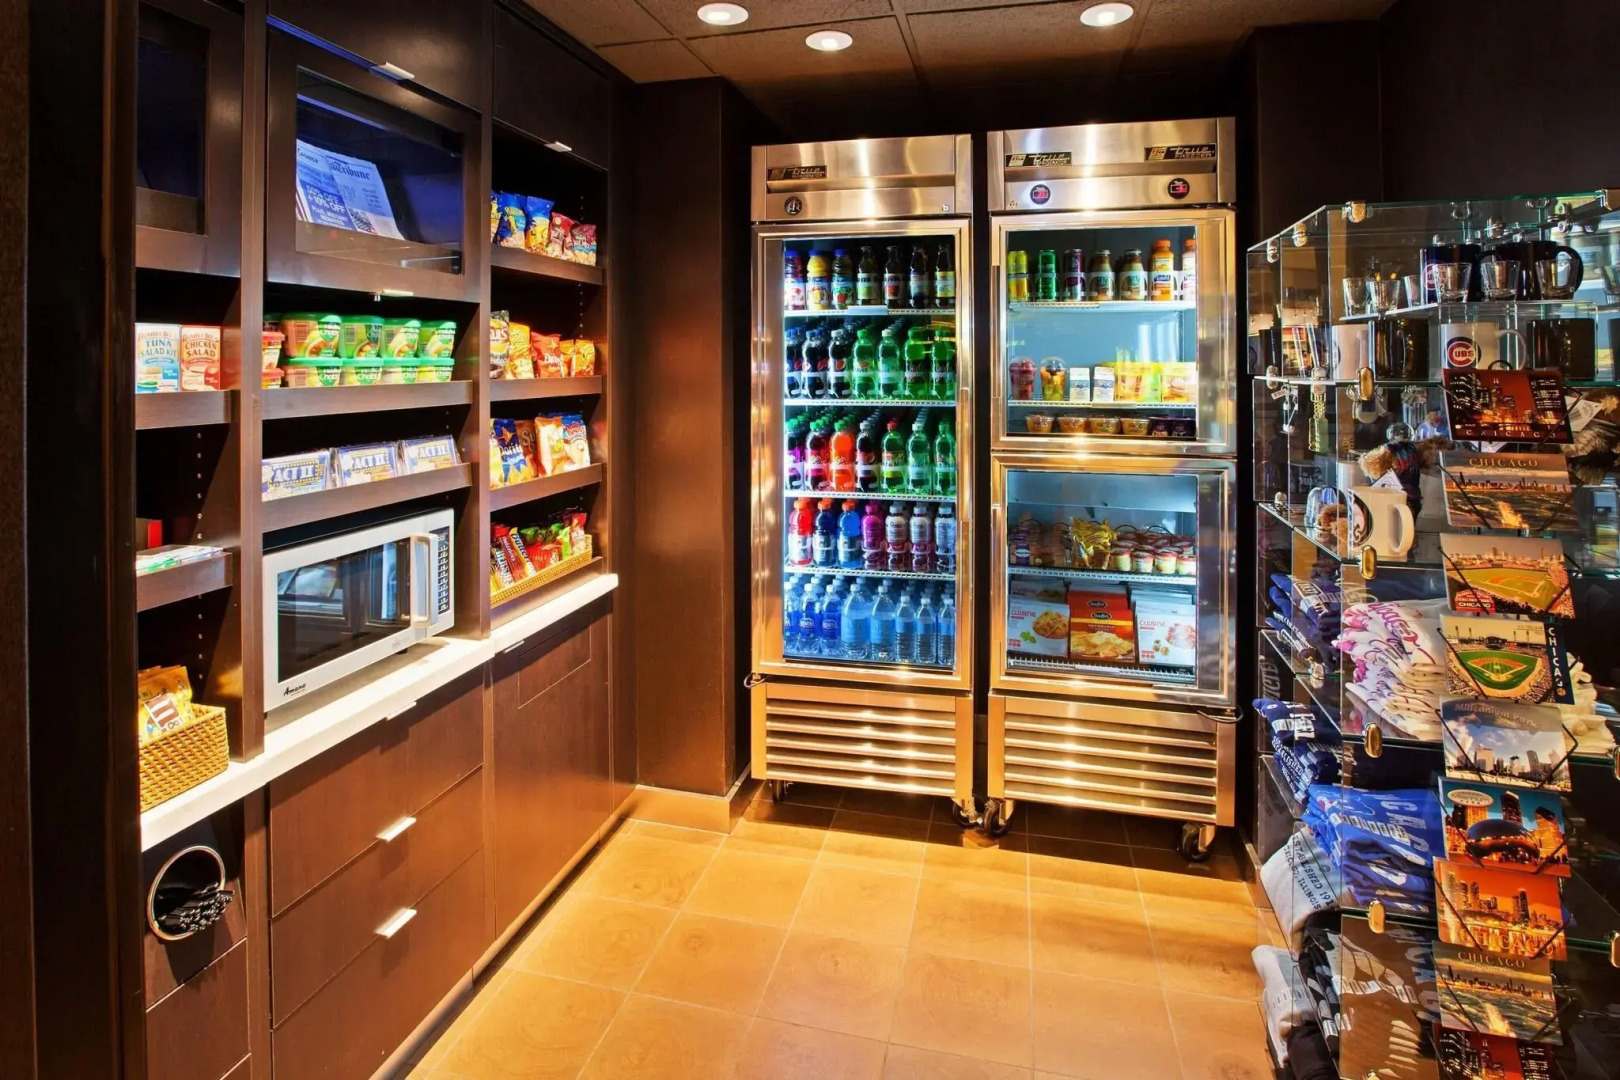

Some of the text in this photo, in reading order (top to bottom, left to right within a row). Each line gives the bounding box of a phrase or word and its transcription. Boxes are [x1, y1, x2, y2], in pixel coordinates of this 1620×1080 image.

[331, 201, 346, 213] OFF
[145, 339, 172, 348] TUNA
[185, 341, 217, 350] CHICKEN
[140, 348, 165, 357] SALAD
[186, 349, 216, 358] SALAD
[1448, 341, 1476, 368] CUBS
[419, 445, 437, 457] ACT
[354, 454, 373, 468] ACT
[1469, 458, 1538, 467] CHICAGO
[273, 466, 299, 482] ACT
[1011, 609, 1037, 618] cuisine
[1139, 619, 1166, 627] cuisine
[283, 683, 307, 696] Amana
[1454, 702, 1511, 718] Millennium
[1298, 877, 1322, 910] ILLINOIS
[1457, 951, 1525, 968] CHICAGO
